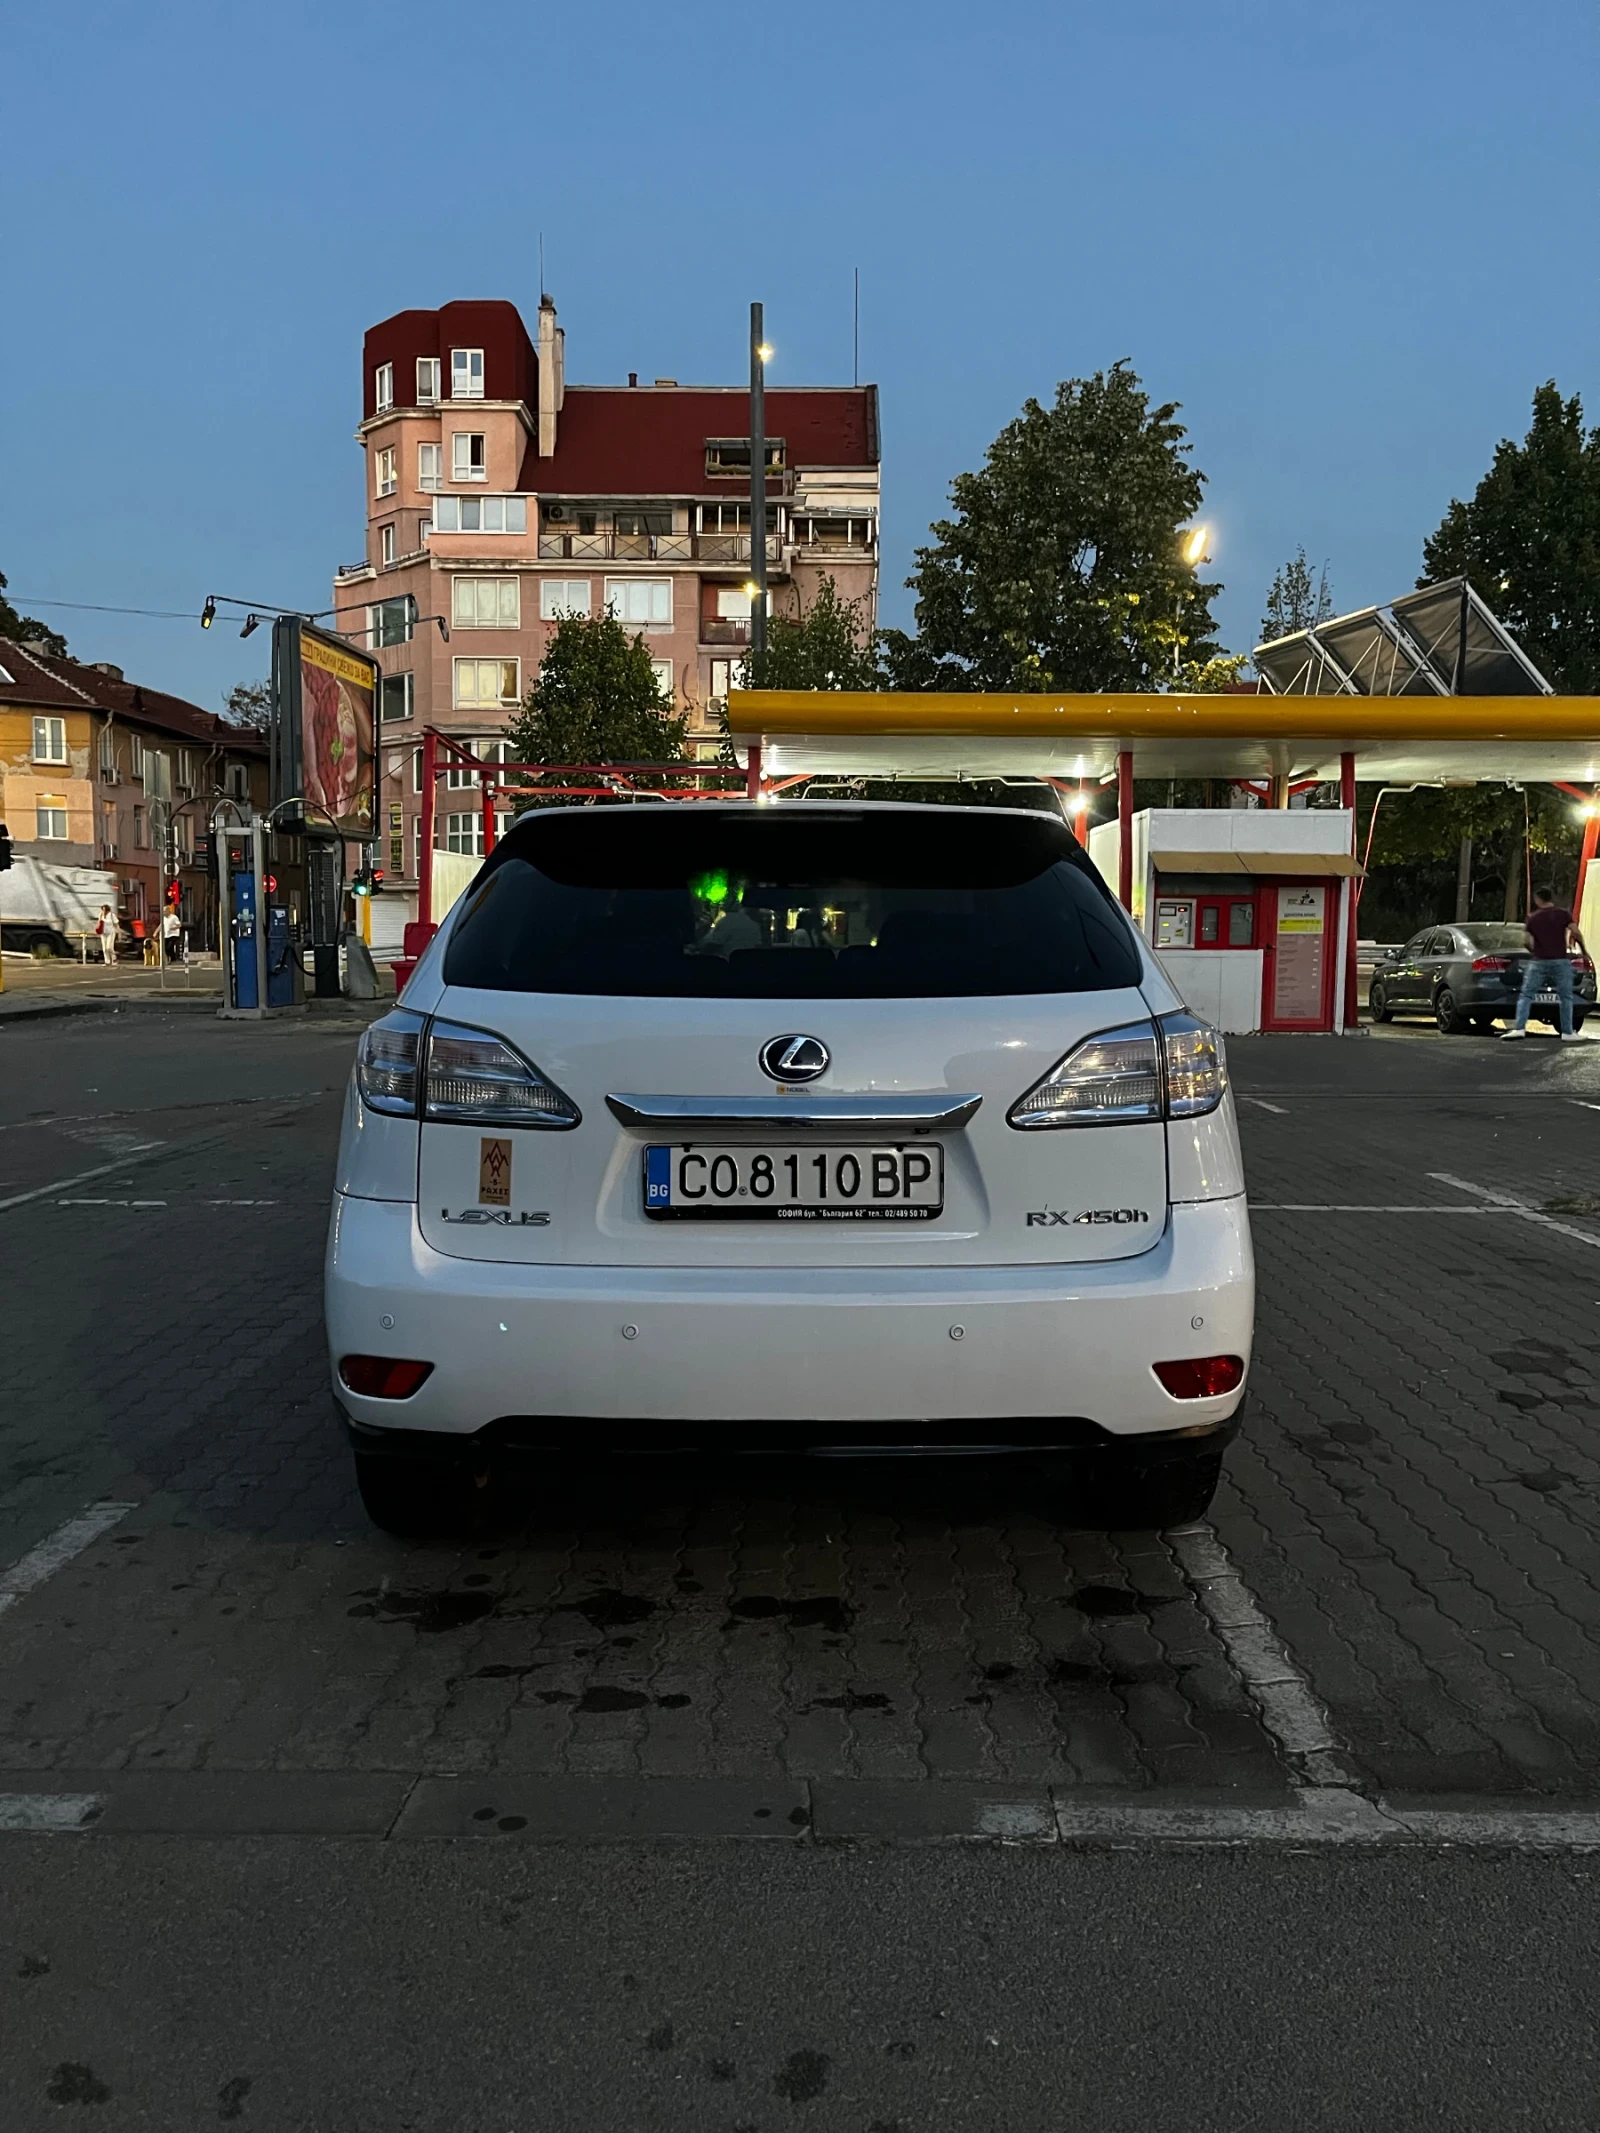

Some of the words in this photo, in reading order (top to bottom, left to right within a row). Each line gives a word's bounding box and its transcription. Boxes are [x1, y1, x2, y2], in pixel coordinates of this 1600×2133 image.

[750, 1154, 861, 1198] 8110
[872, 1154, 931, 1198] BP
[649, 1184, 668, 1198] BG
[442, 1208, 551, 1227] LEXUS
[777, 1209, 803, 1218] СОФИЯ
[909, 1209, 918, 1218] 50
[919, 1209, 928, 1218] 70
[1026, 1210, 1070, 1226] RX
[1072, 1208, 1149, 1225] 450h
